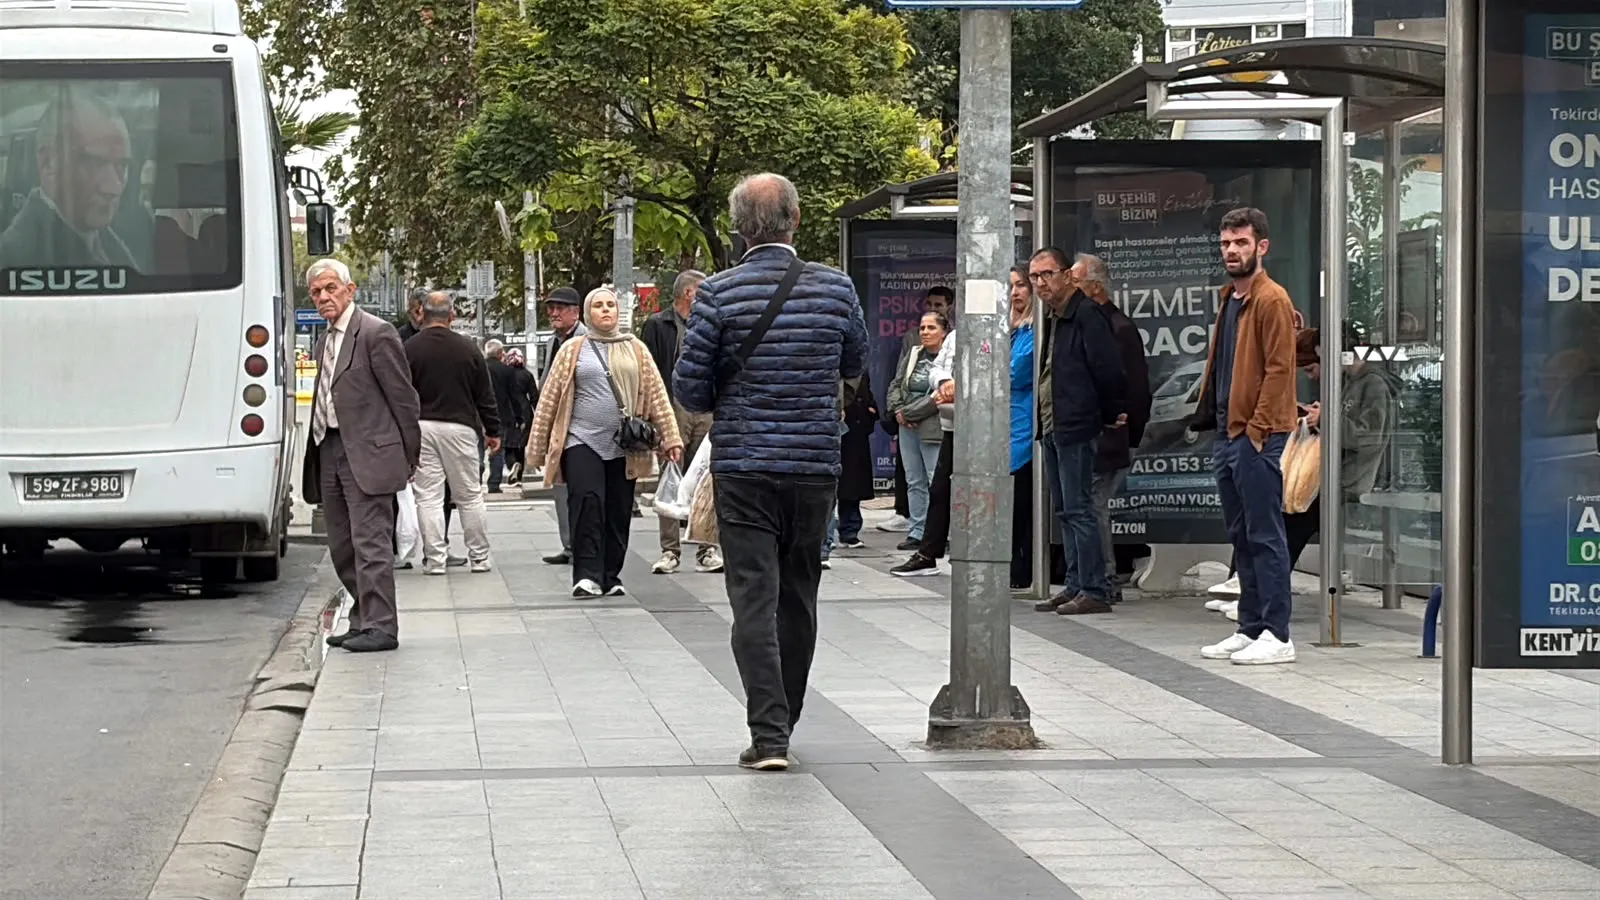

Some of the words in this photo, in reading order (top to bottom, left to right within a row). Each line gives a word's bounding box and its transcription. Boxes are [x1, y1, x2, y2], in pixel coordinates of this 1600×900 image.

[1551, 32, 1581, 51] BU
[1549, 133, 1600, 169] ON
[1549, 177, 1600, 200] HAS
[1097, 194, 1116, 206] BU
[1119, 192, 1157, 208] ŞEHİR
[1121, 208, 1158, 221] BİZİM
[1548, 216, 1600, 251] UL
[9, 268, 126, 290] ISUZU
[1548, 267, 1600, 302] DE
[1131, 459, 1168, 474] ALO
[1170, 457, 1200, 472] 153
[33, 478, 52, 493] 59
[62, 477, 81, 492] ZF
[90, 477, 119, 492] 980
[1107, 497, 1129, 509] DR.
[1130, 494, 1186, 508] CANDAN
[1187, 493, 1222, 506] YÜCE
[1111, 520, 1146, 534] İZYON
[1549, 583, 1586, 603] DR.
[1525, 627, 1600, 652] KENTVİZ
